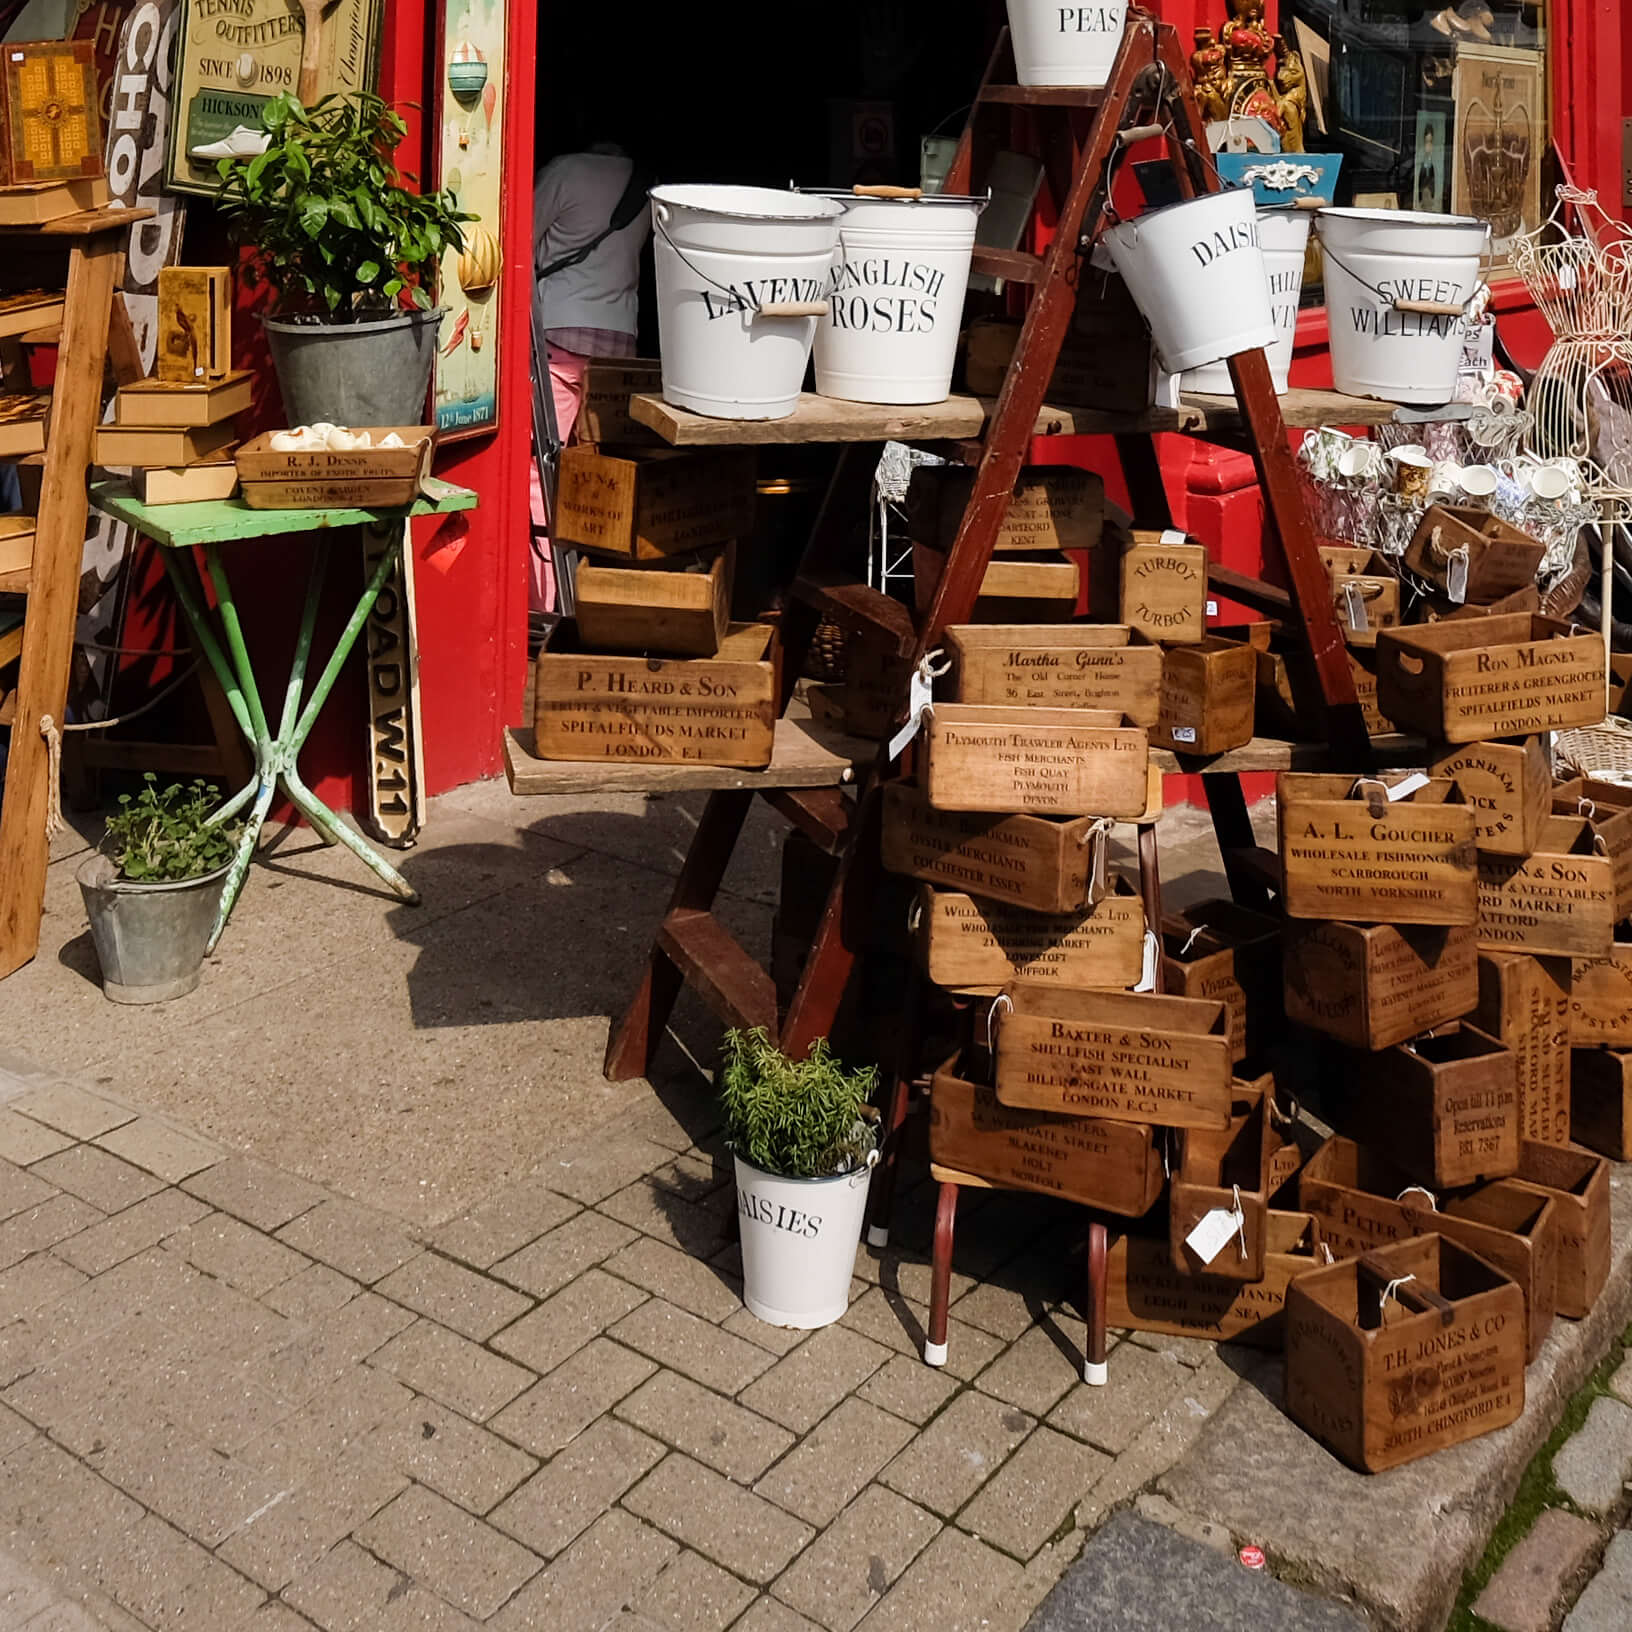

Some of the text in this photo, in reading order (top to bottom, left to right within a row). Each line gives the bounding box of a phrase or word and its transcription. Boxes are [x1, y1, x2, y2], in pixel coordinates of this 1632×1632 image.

[215, 13, 304, 46] OUTFITTERS
[1058, 7, 1121, 34] PEAS
[199, 58, 293, 86] SINCE 1898
[829, 258, 947, 297] ENGLISH
[1377, 278, 1463, 305] SWEET
[831, 296, 938, 335] ROSES
[1351, 306, 1467, 339] WILLIAMS
[455, 410, 472, 426] June
[472, 407, 489, 423] 1871
[287, 456, 302, 467] R.
[307, 456, 320, 467] J.
[260, 469, 306, 478] IMPORTER
[581, 521, 605, 535] ART
[1011, 535, 1037, 545] KENT
[1133, 555, 1198, 584] TURBOT
[1134, 602, 1193, 629] TURBOT
[1002, 651, 1125, 670] Martha Gunn's
[1476, 648, 1577, 673] RON MAGNEY
[576, 671, 738, 699] P. HEARD & SON
[1445, 679, 1511, 700] FRUITERER
[1511, 679, 1521, 692] &
[686, 706, 762, 720] IMPORTERS
[1458, 689, 1594, 717] SPITALFIELDS MARKET
[560, 719, 750, 741] SPITALFIELDS MARKET
[1493, 716, 1543, 734] LONDON
[605, 742, 673, 759] LONDON
[945, 731, 1008, 750] PLYMOUTH
[1009, 733, 1064, 750] TRAWLER
[1066, 736, 1111, 752] AGENTS
[997, 753, 1086, 765] FISH MERCHANTS
[1013, 767, 1070, 779] FISH QUAY
[1013, 781, 1070, 793] PLYMOUTH
[1023, 795, 1059, 805] DEVON
[1302, 822, 1456, 845] A. L. GOUCHER
[956, 843, 1027, 873] MERCHANTS
[1290, 847, 1369, 864] WHOLESALE
[913, 854, 985, 884] COLCHESTER
[1330, 868, 1429, 883] SCARBOROUGH
[1533, 867, 1545, 879] &
[1551, 862, 1588, 882] SON
[1316, 885, 1446, 901] NORTH YORKSHIRE
[1508, 881, 1518, 894] &
[1510, 897, 1575, 913] MARKET
[1053, 924, 1115, 936] MERCHANTS
[1048, 938, 1092, 950] MARKET
[1005, 951, 1068, 963] LOWESTOFT
[1013, 966, 1060, 977] SUFFOLK
[1051, 1021, 1173, 1051] BAXTER & SON
[1030, 1041, 1193, 1072] SHELLFISH SPECIALIST
[1069, 1061, 1152, 1083] EAST WALL
[1061, 1092, 1121, 1111] LONDON
[1134, 1083, 1196, 1103] MARKET
[1444, 1096, 1469, 1115] Open
[1415, 1327, 1466, 1362] JONES
[1469, 1322, 1480, 1342] &
[1484, 1313, 1506, 1337] CO
[1426, 1399, 1495, 1435] CHINGFORD
